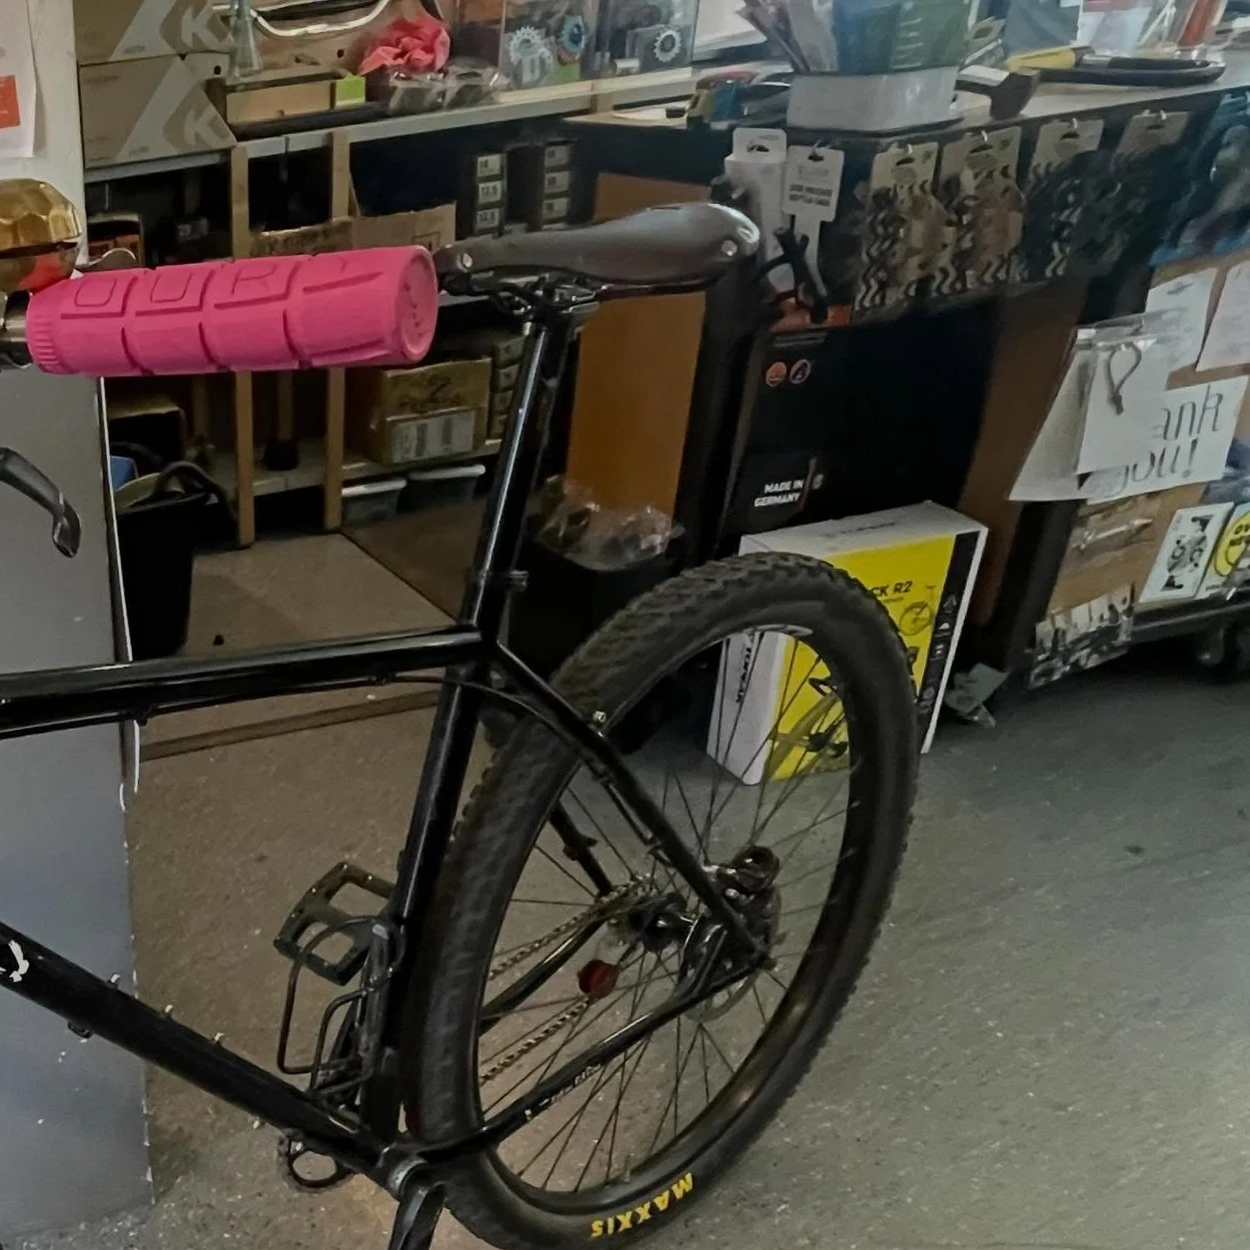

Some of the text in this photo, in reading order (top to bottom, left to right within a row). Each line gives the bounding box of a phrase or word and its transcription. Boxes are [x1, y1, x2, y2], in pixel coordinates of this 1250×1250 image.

[764, 479, 804, 494] MADE IN
[754, 492, 801, 507] GERMANY
[893, 580, 914, 594] R2
[590, 1172, 693, 1237] MAXXIS
